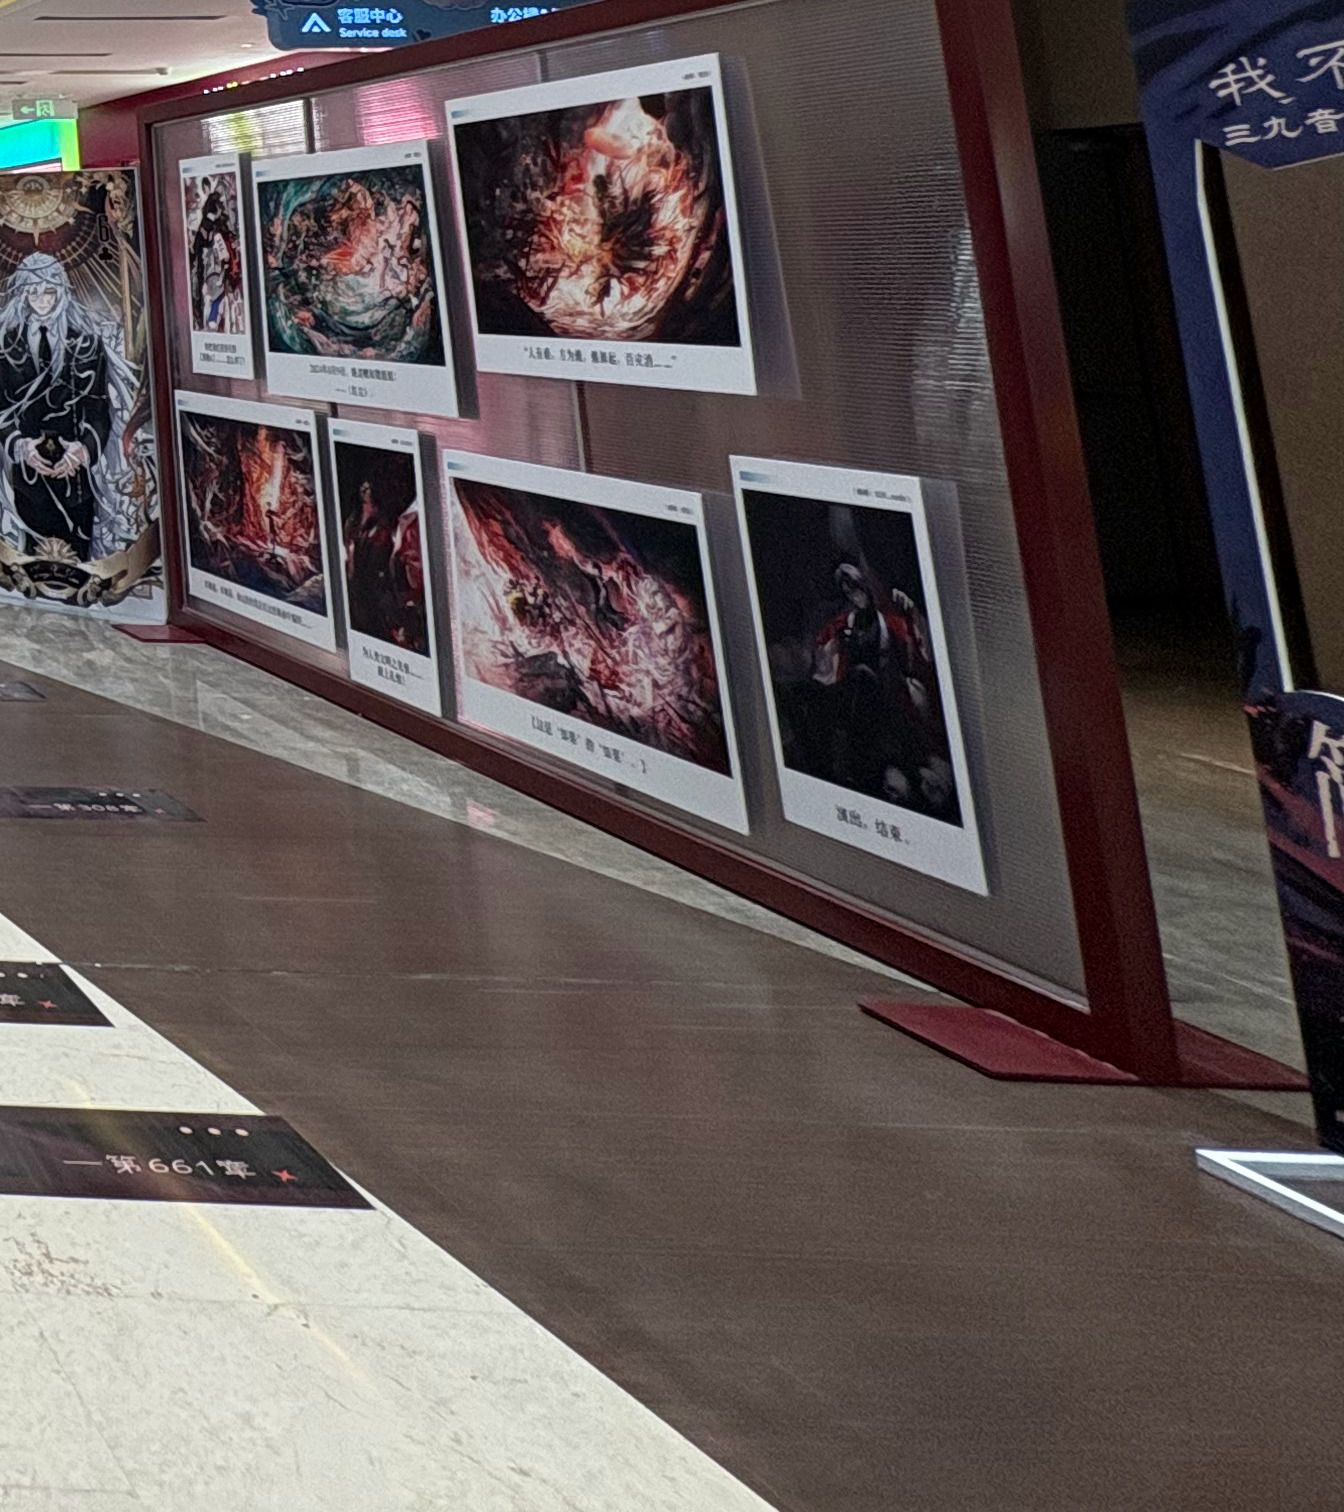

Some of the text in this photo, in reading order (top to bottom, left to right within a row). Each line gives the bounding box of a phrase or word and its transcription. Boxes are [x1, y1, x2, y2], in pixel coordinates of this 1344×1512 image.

[337, 8, 404, 24] 客服中心
[339, 28, 407, 38] Service desk
